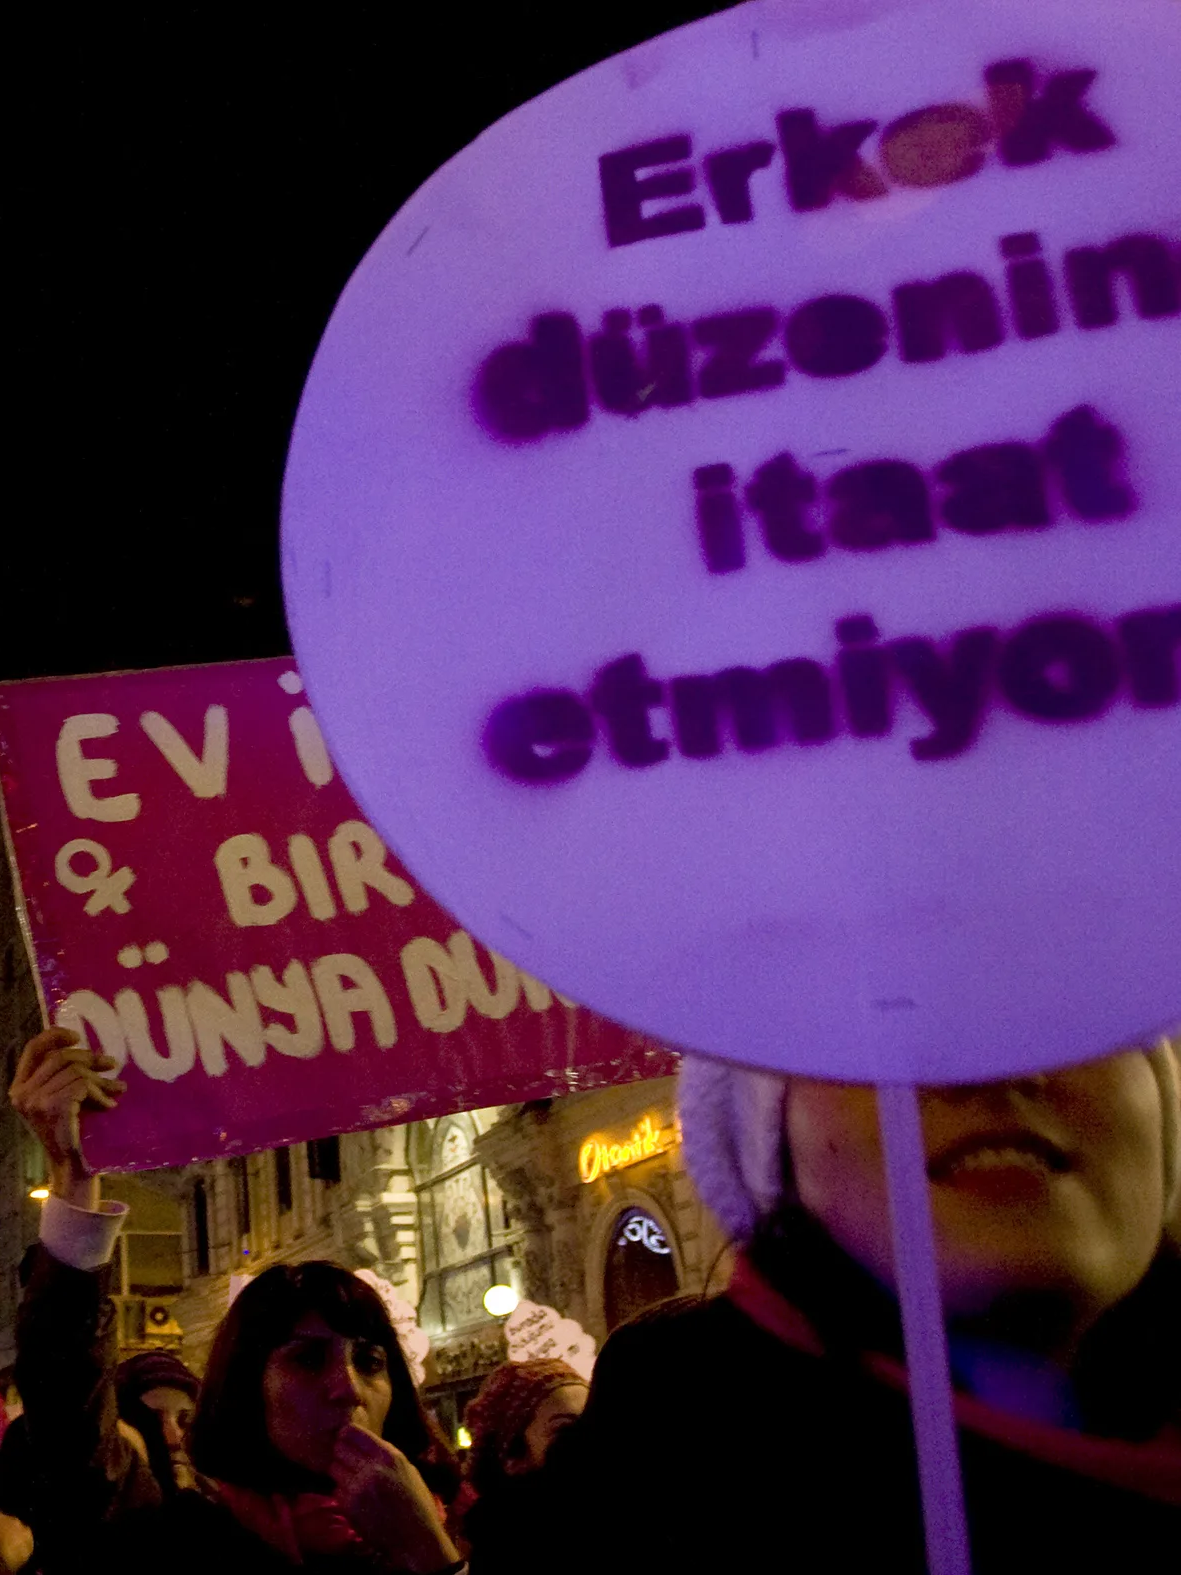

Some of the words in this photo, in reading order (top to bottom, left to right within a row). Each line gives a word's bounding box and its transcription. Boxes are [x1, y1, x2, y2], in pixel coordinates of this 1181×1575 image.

[598, 58, 1117, 247] Erkek
[472, 232, 1181, 443] düzenin
[692, 404, 1138, 574] itaat
[55, 704, 229, 823] EV
[481, 604, 1181, 786] etmiyor
[56, 940, 399, 1083] DÜNYA
